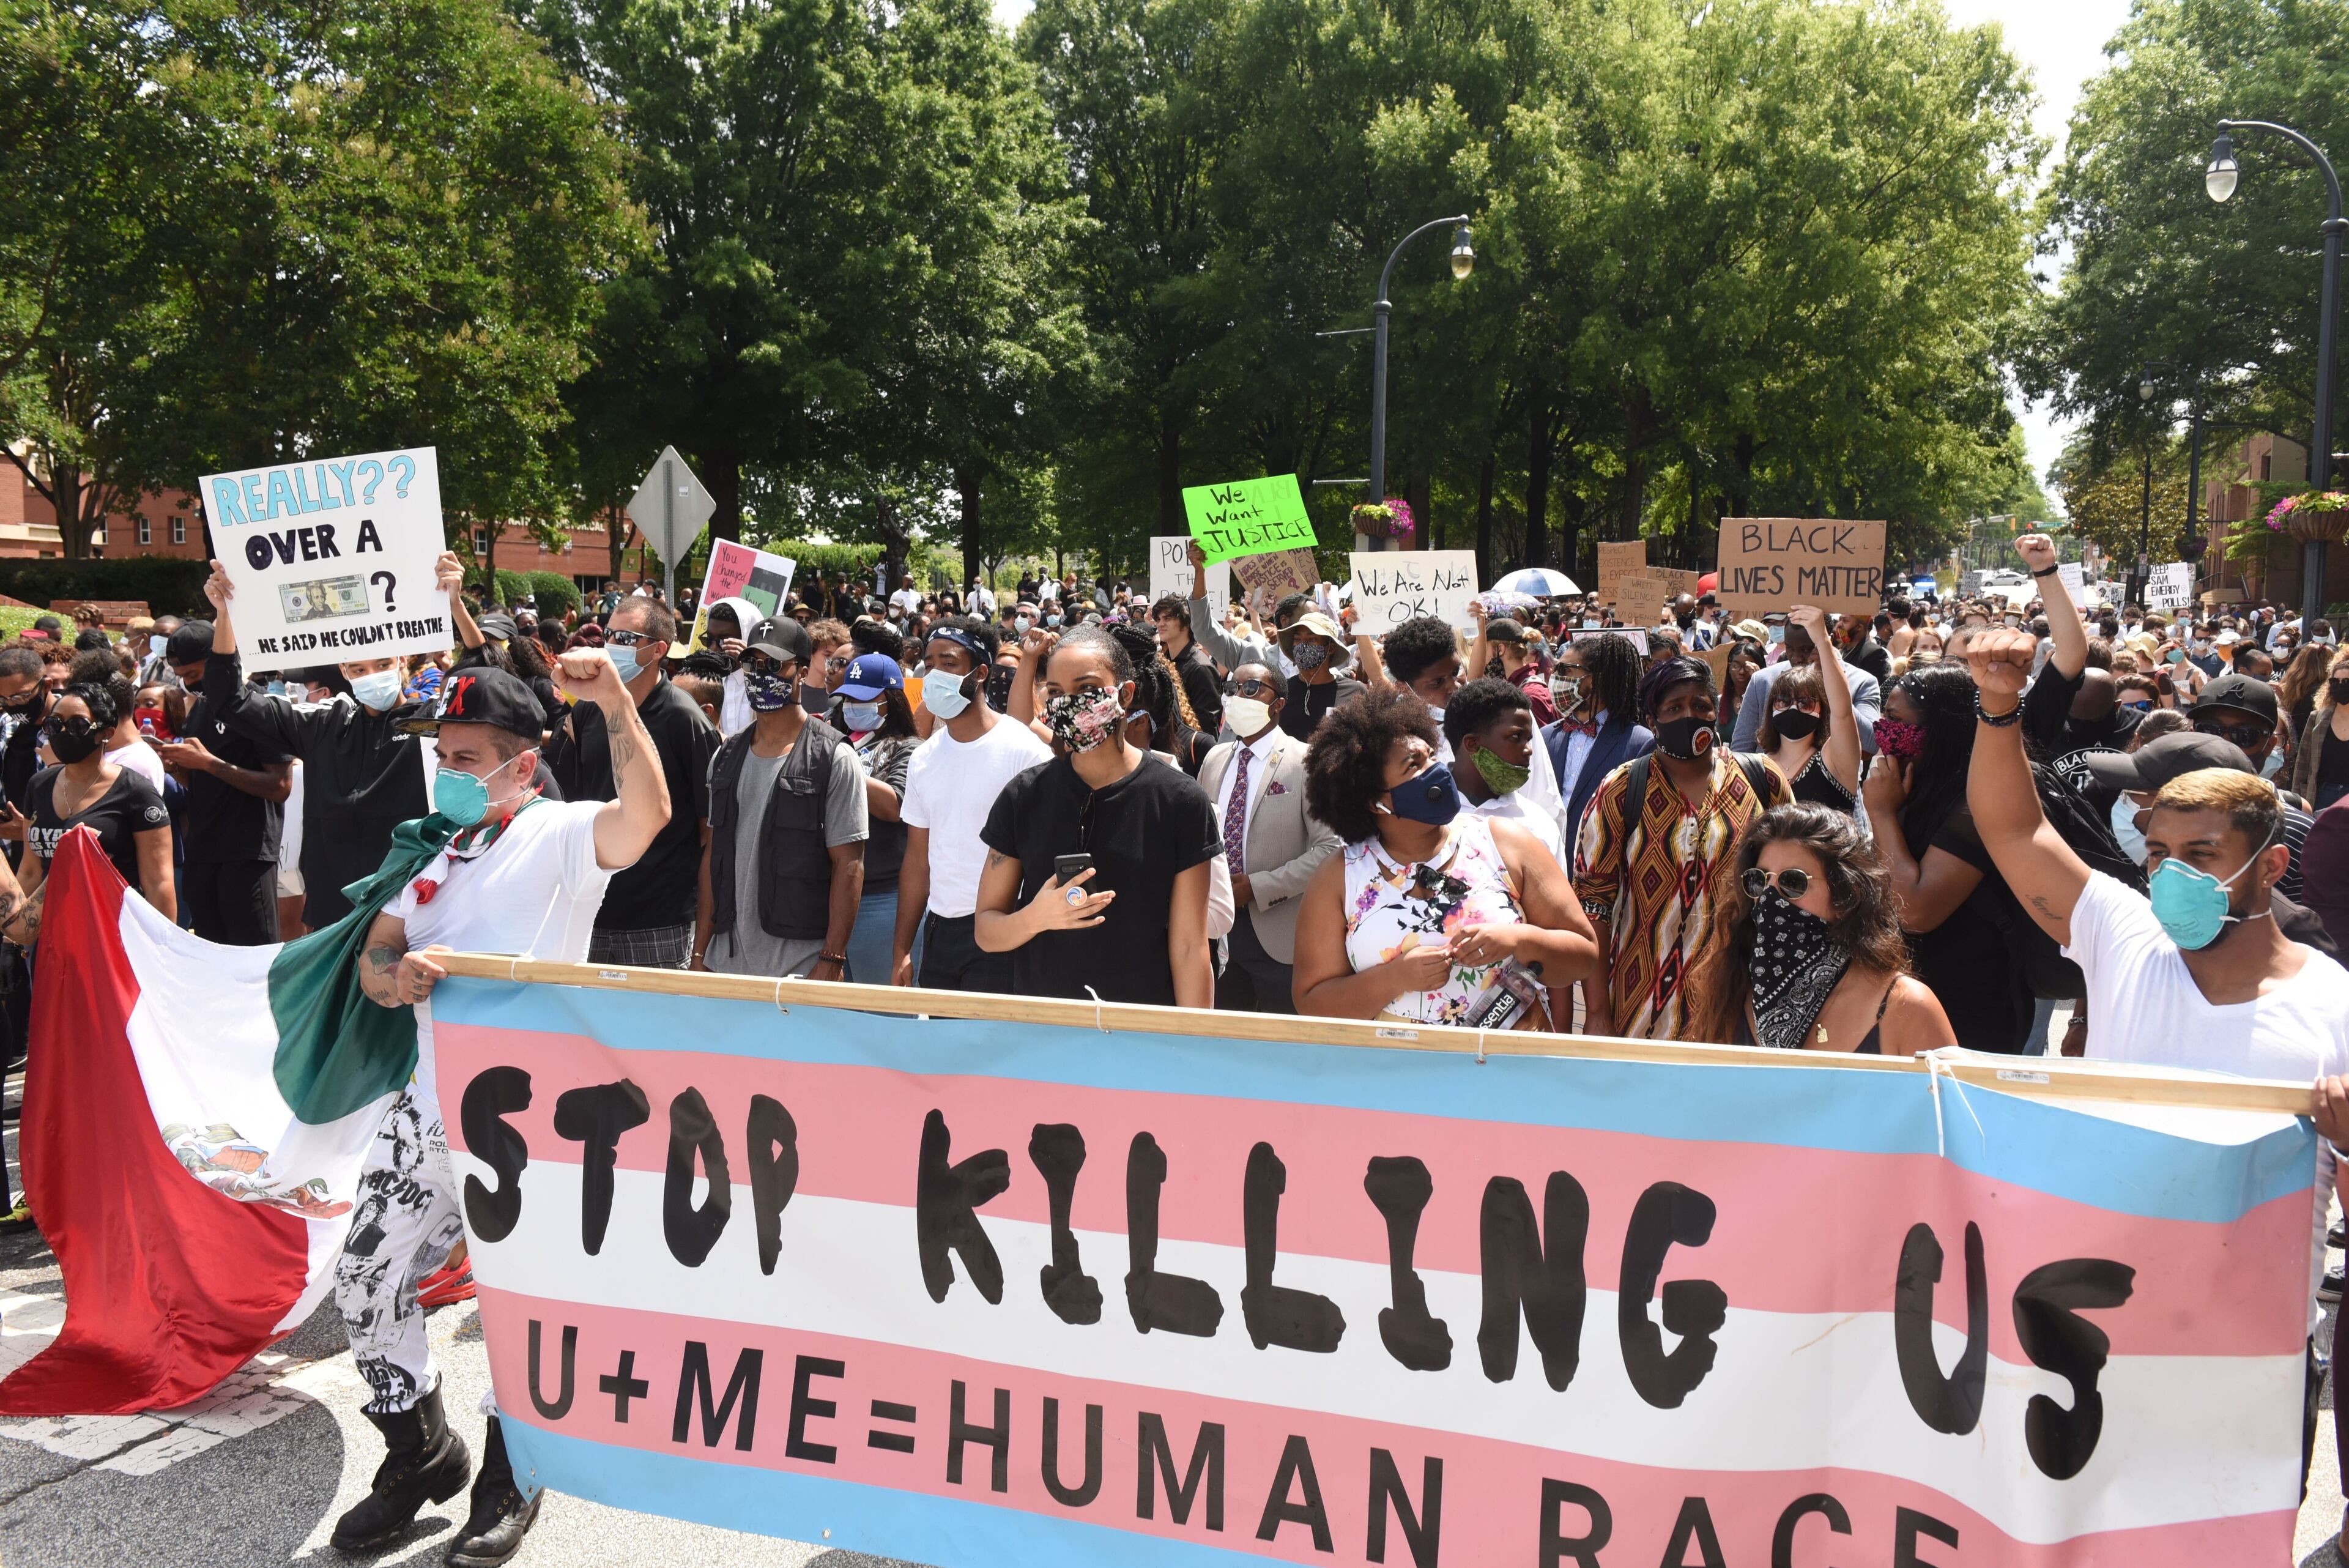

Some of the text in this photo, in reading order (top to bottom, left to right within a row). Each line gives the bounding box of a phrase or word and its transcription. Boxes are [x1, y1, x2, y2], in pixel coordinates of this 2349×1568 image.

[212, 455, 415, 527] REALLY??
[1210, 485, 1245, 505] We
[1206, 505, 1263, 525] Want
[1203, 516, 1312, 553] JUSTICE
[1742, 524, 1855, 554] BLACK
[245, 519, 383, 571] OVER A
[1598, 545, 1627, 554] RESPECT
[722, 547, 738, 563] You
[1161, 540, 1193, 568] POL
[1261, 553, 1278, 570] WHEN
[1598, 557, 1635, 568] EXISTENCE
[716, 564, 748, 584] changed
[1239, 559, 1256, 577] HIDES
[1254, 563, 1281, 588] JUSTICE
[1609, 569, 1640, 581] EXPECT
[1656, 569, 1685, 579] BLACK
[2150, 564, 2169, 575] KEEP
[720, 578, 731, 589] the
[1174, 573, 1195, 586] TH
[1267, 567, 1293, 590] SERVED
[1357, 568, 1469, 596] We Are Not
[1631, 580, 1656, 589] WHITE
[1720, 565, 1882, 598] LIVES MATTER
[370, 571, 397, 612] ?
[1599, 587, 1619, 598] RESIS
[1621, 589, 1657, 602] SILENCE
[2151, 584, 2180, 596] ENERGY
[2162, 596, 2190, 608] POLLS!
[1618, 611, 1658, 621] VIOLENCE
[282, 634, 317, 652] SAID
[321, 631, 340, 648] HE
[340, 622, 394, 647] COULDN'T
[850, 662, 862, 679] LA
[392, 733, 410, 741] adid
[1479, 994, 1513, 1028] ssentia
[461, 1066, 2136, 1481] STOP KILLING US
